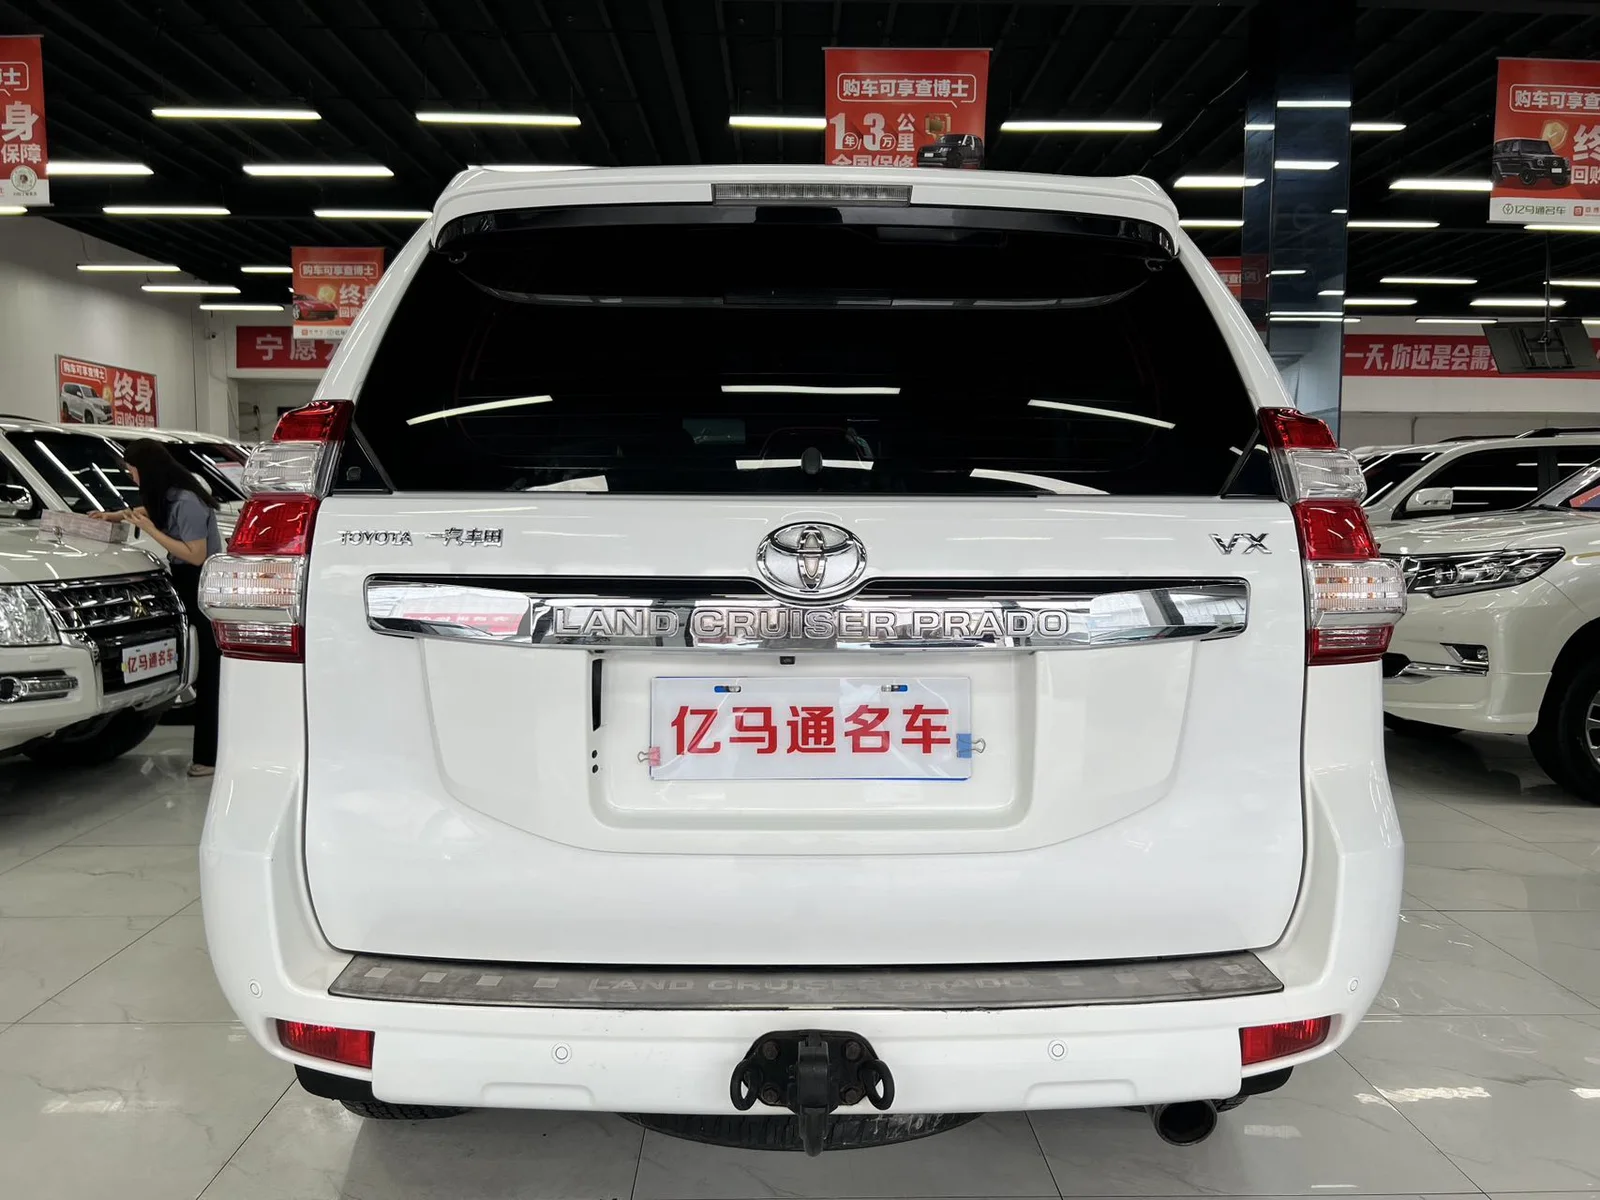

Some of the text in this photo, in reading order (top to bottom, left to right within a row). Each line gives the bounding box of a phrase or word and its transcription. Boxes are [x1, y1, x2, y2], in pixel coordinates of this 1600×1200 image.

[843, 79, 969, 97] 购车可享查博士
[1, 101, 39, 142] 身
[2, 143, 42, 164] 保障
[302, 264, 374, 276] 购车可享查博士
[114, 371, 153, 413] 终身
[337, 529, 413, 546] TOYOTA
[1208, 533, 1272, 555] VX
[553, 606, 1071, 639] LAND CRUISER PRADO
[127, 648, 174, 674] 亿马通名车
[671, 704, 951, 755] 亿马通名车
[588, 977, 694, 991] LAND
